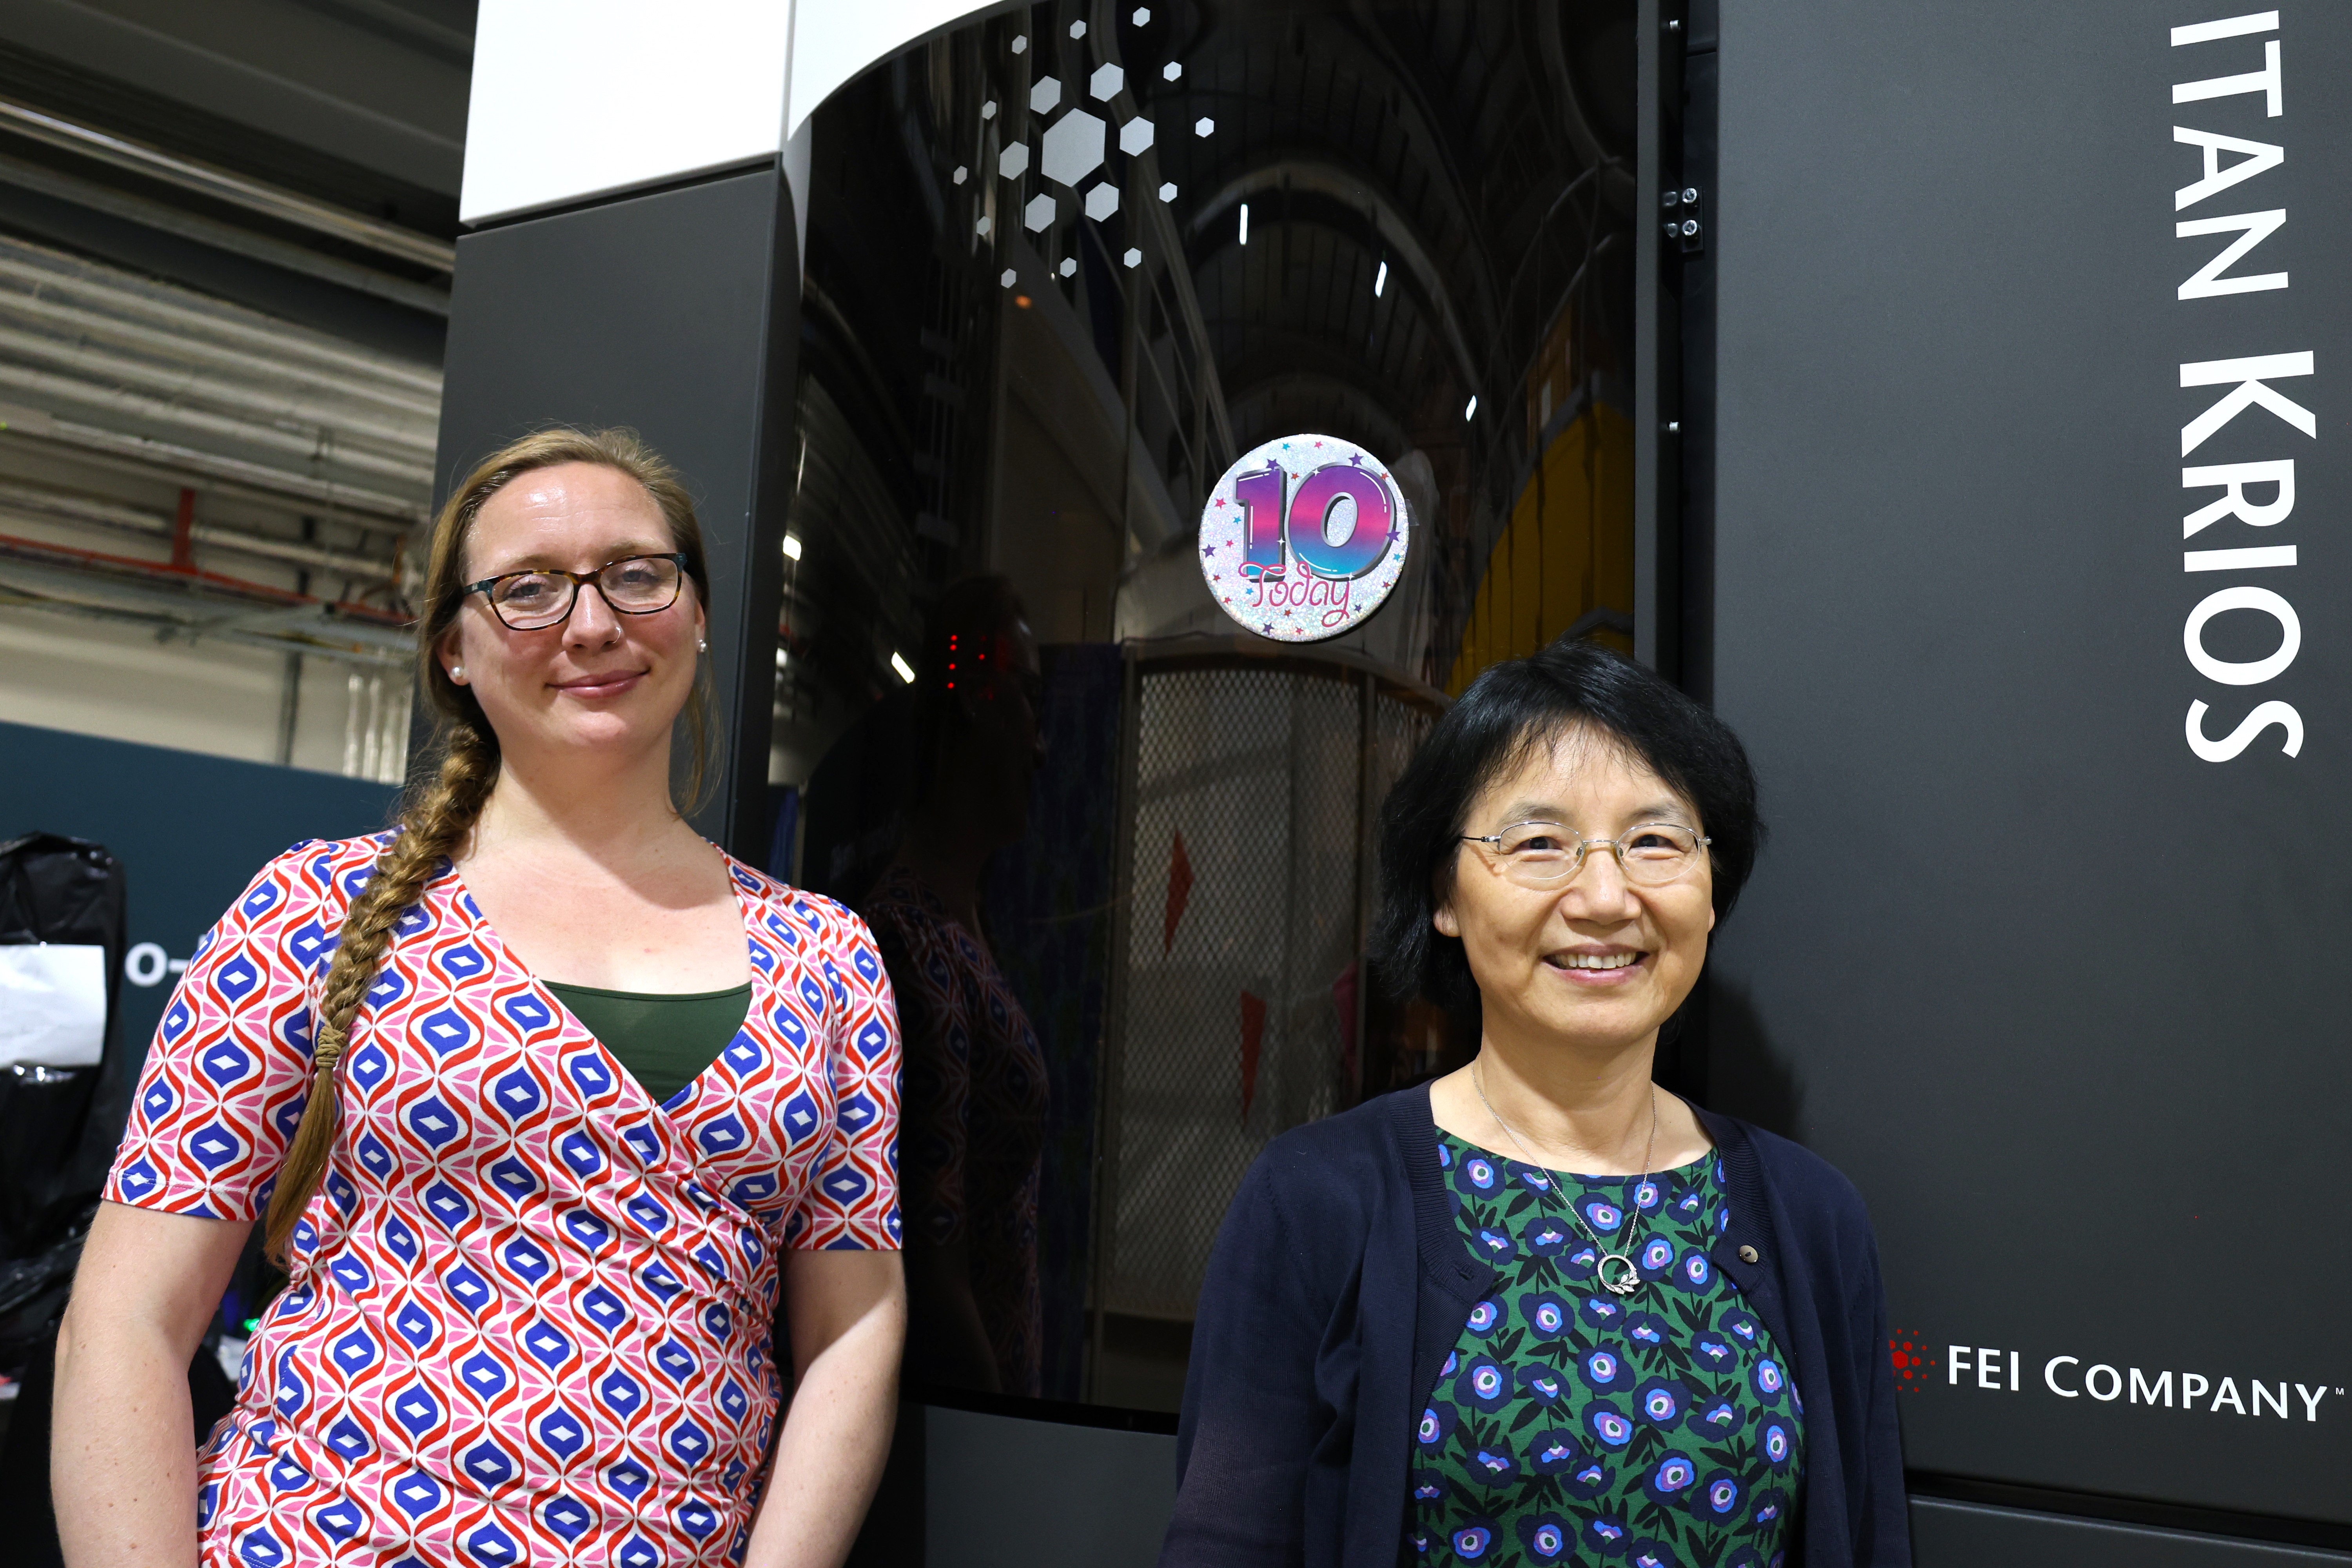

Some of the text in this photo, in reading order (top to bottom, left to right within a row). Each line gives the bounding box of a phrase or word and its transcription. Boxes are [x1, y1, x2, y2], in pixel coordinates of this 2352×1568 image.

[2171, 10, 2316, 762] ITAN KRIOS
[1233, 461, 1397, 582] 10
[1238, 561, 1350, 627] Today
[1949, 1345, 2019, 1391] FEI
[2044, 1356, 2327, 1421] COMPANY
